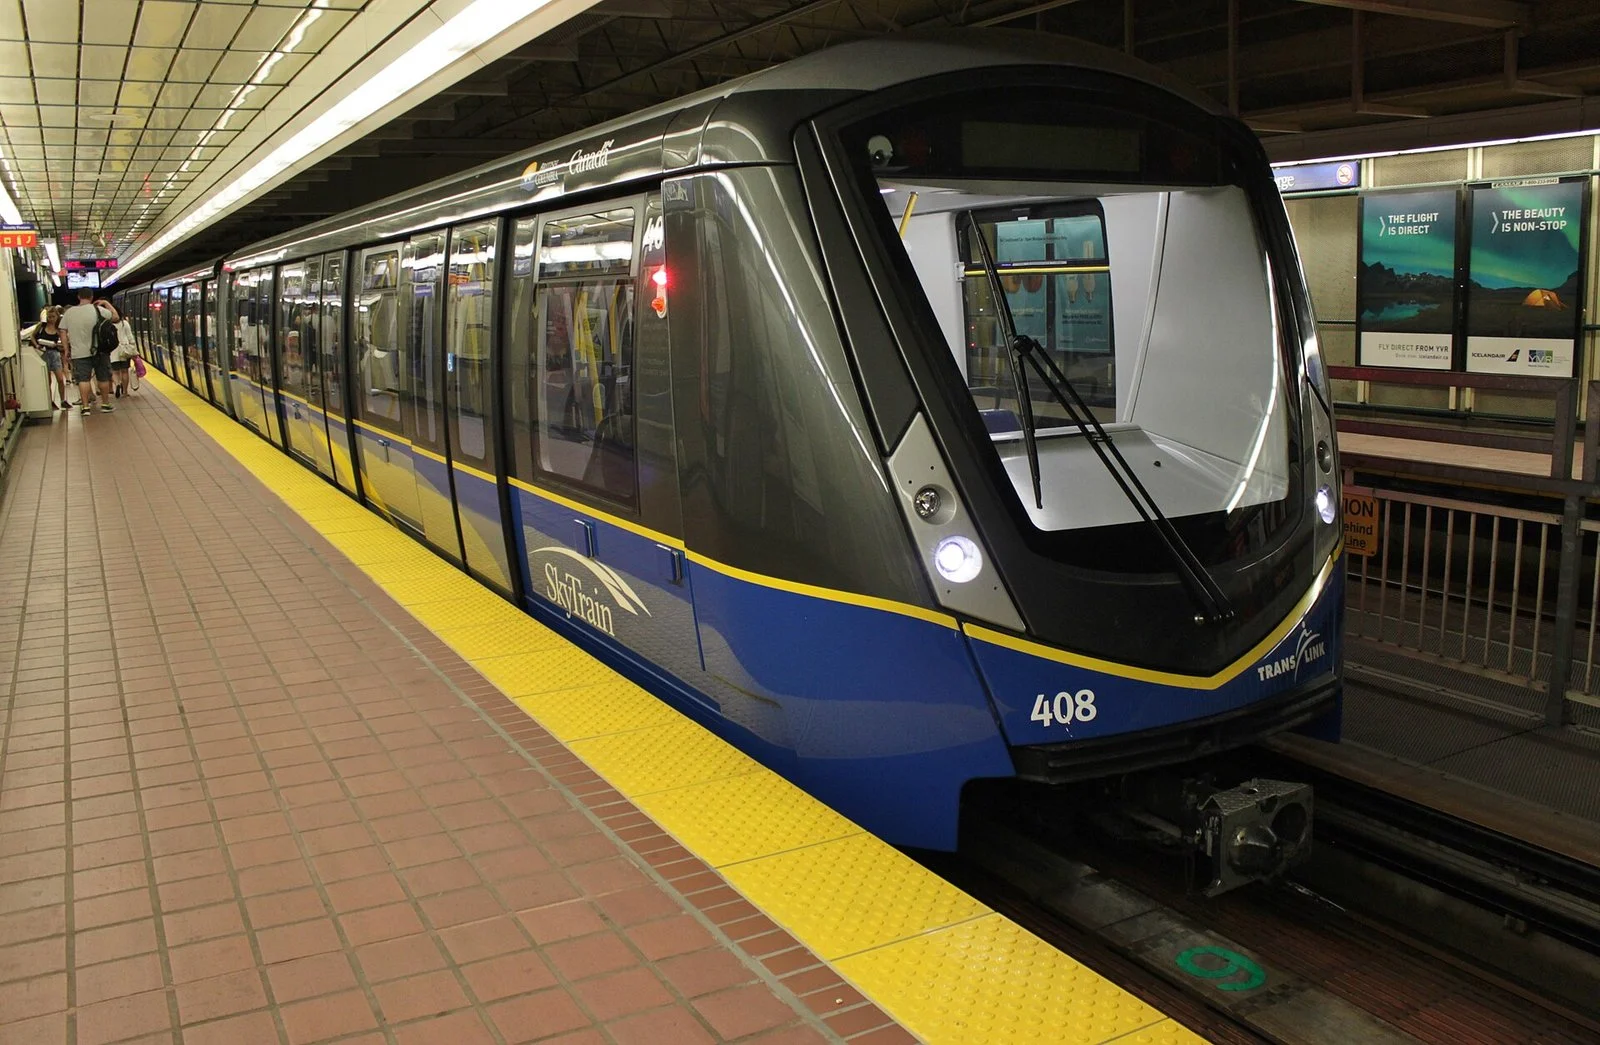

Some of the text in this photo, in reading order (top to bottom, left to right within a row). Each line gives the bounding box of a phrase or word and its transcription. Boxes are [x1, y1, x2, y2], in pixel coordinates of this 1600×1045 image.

[568, 139, 614, 175] Canada
[1388, 212, 1439, 224] THE FLIGHT
[1502, 207, 1566, 220] THE BEAUTY
[1388, 225, 1430, 235] IS DIRECT
[1501, 220, 1568, 233] IS NON-STOP
[1378, 343, 1390, 351] FLY
[1435, 345, 1449, 353] YVR
[1343, 498, 1374, 517] ION
[545, 562, 616, 637] SkyTrain
[1030, 689, 1098, 728] 408
